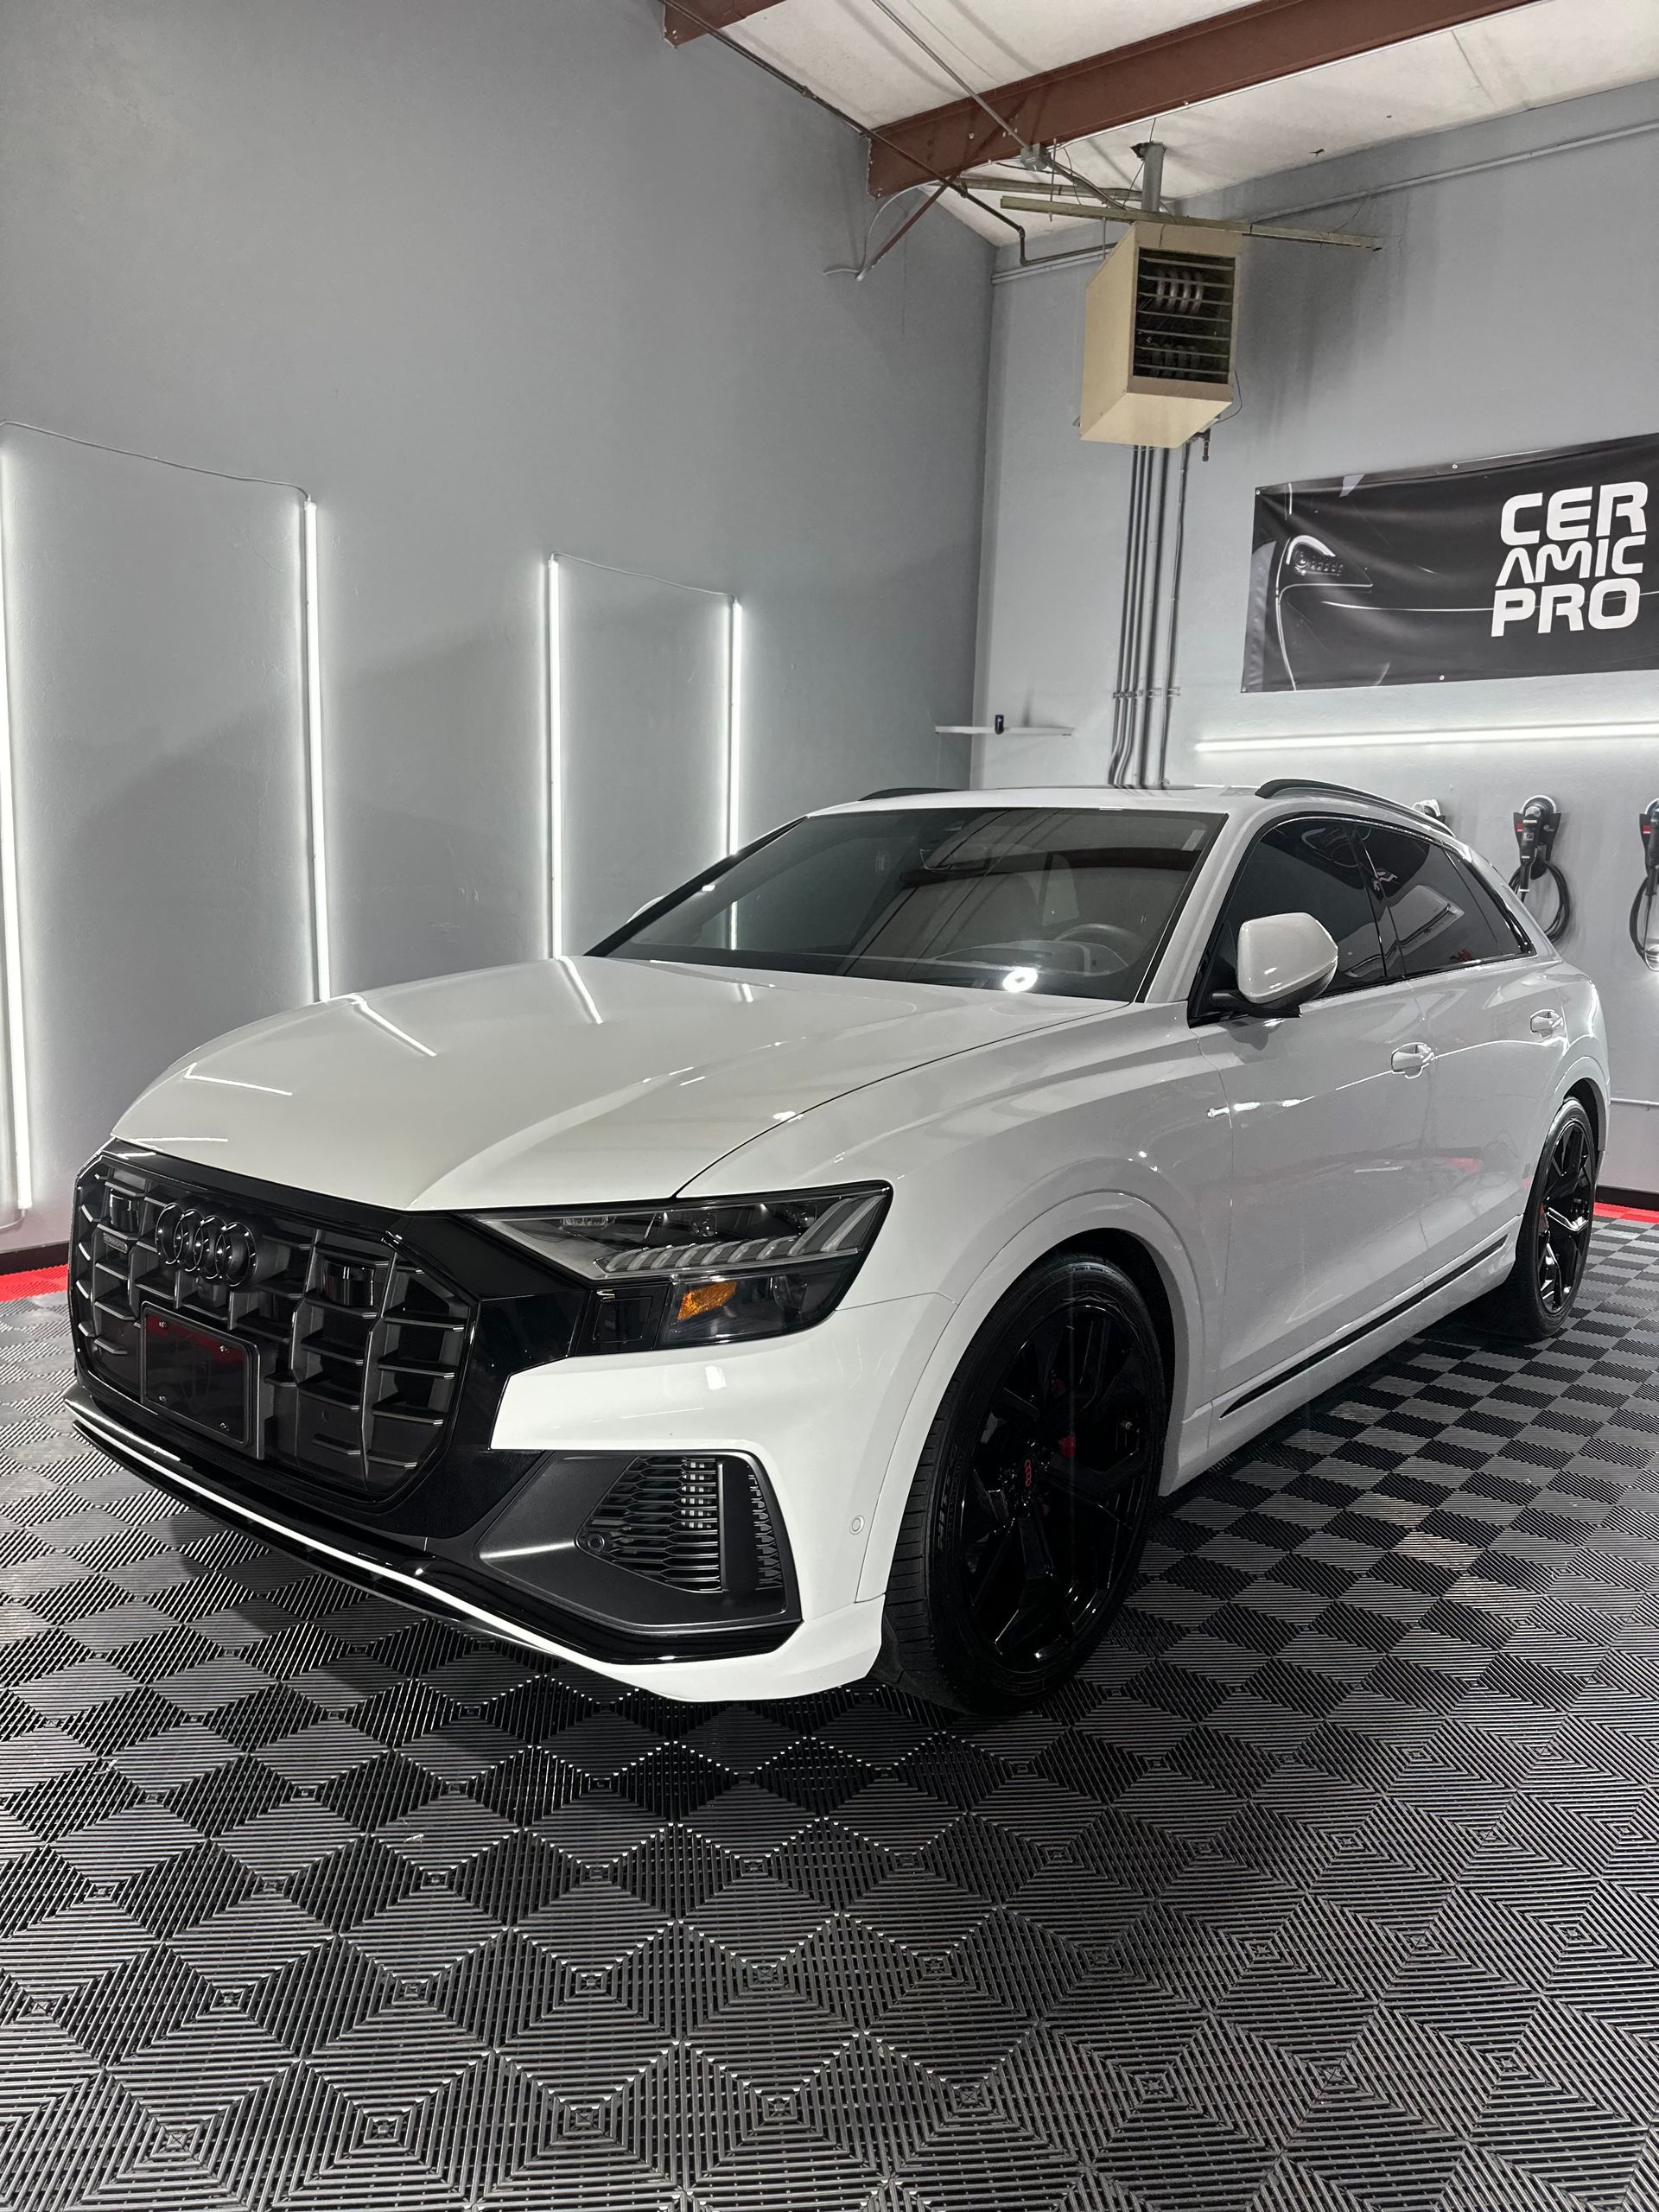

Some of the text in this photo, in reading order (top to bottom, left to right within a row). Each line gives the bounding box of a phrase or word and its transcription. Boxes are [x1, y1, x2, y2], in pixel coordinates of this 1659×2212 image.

[1501, 481, 1648, 545] CER
[1496, 535, 1646, 586] AMIC
[1491, 578, 1640, 637] PRO
